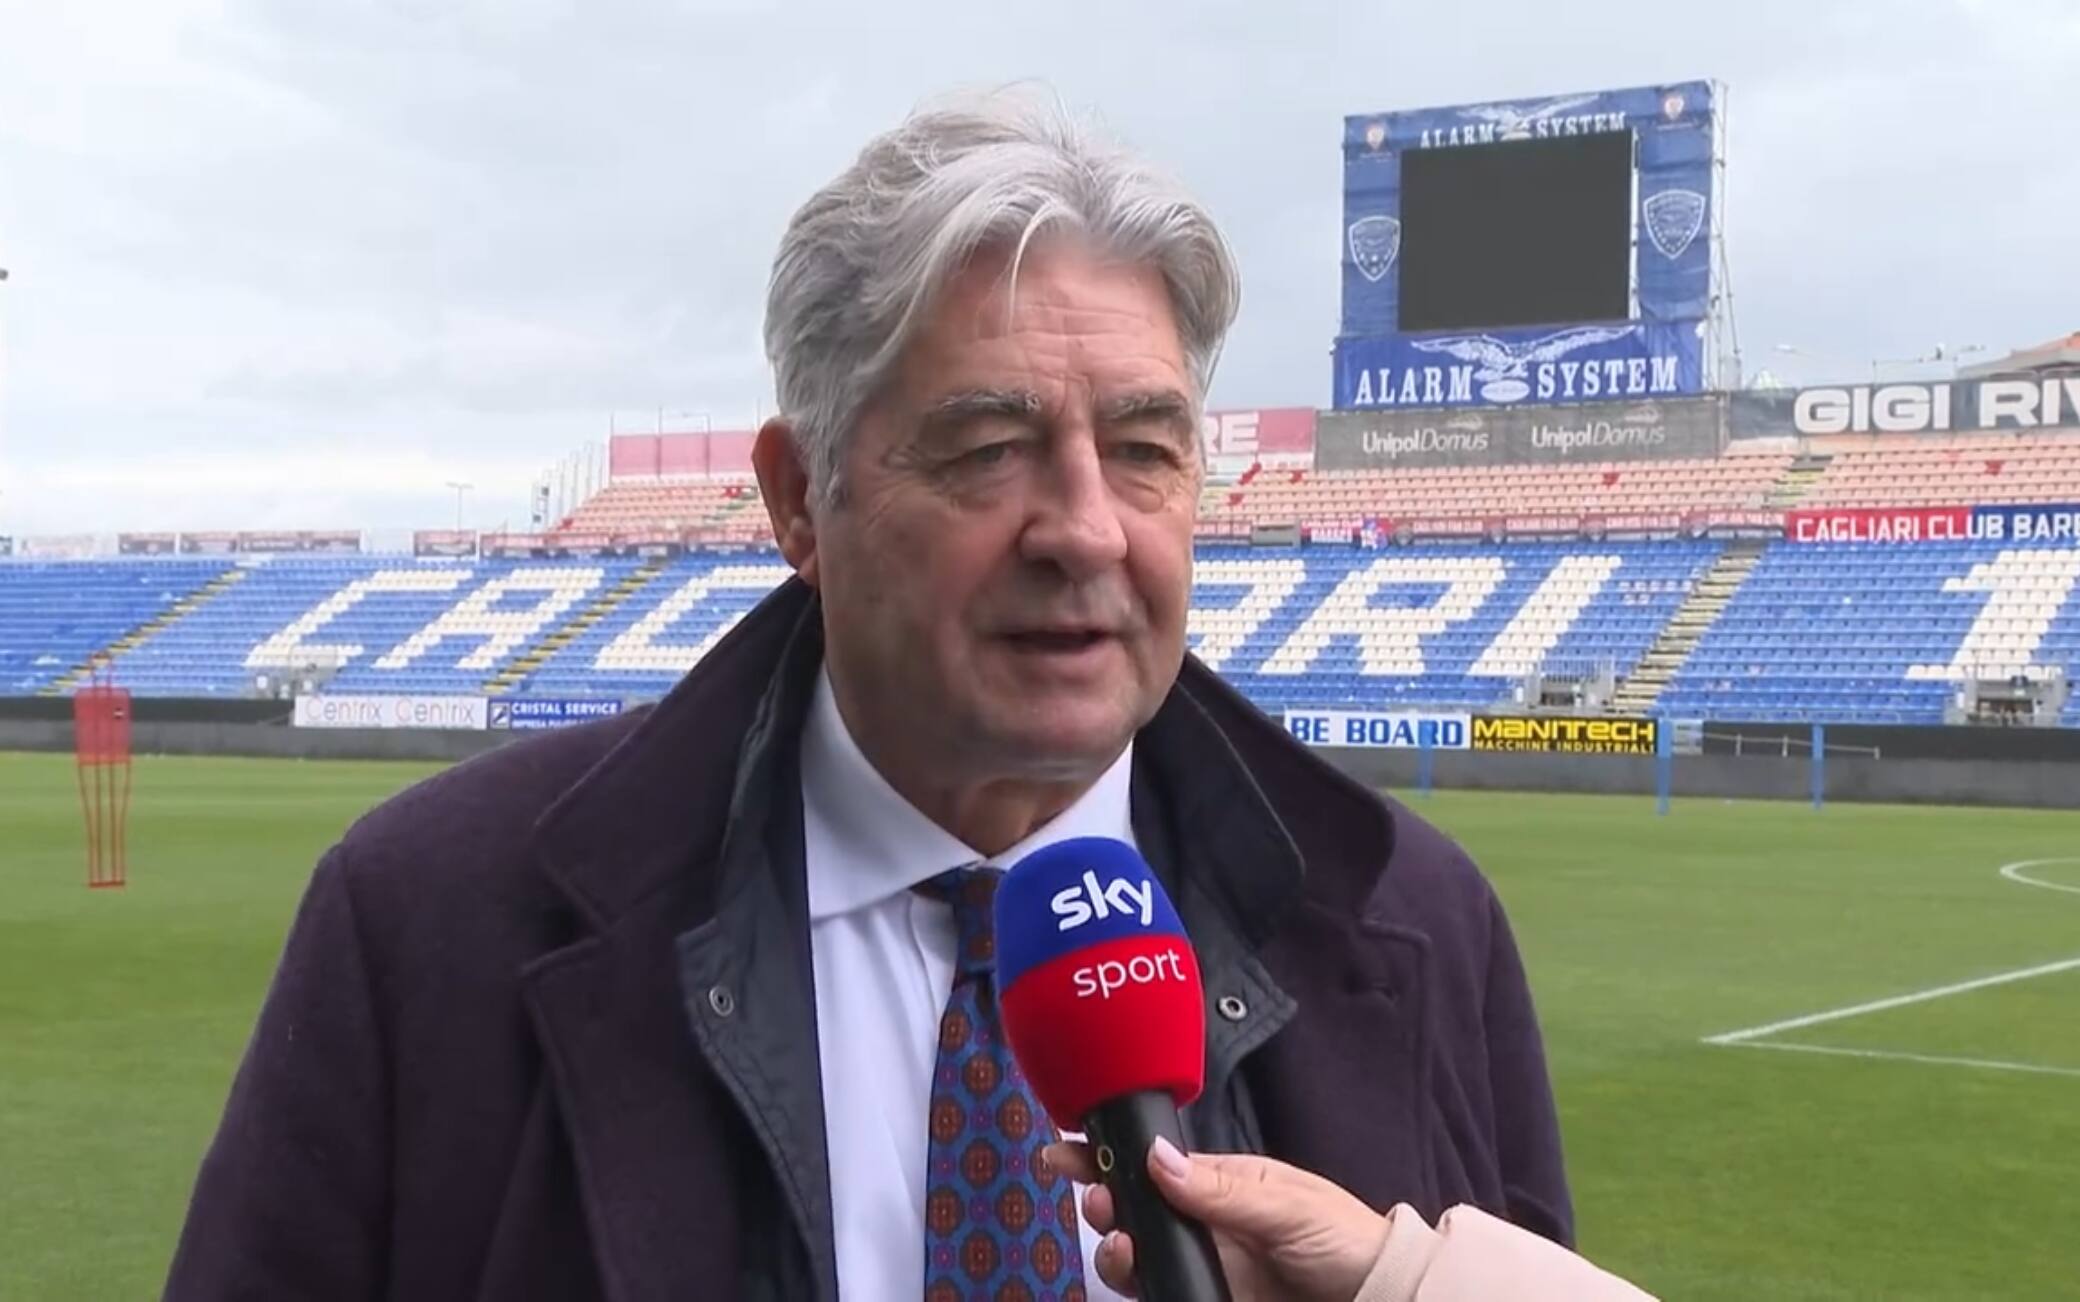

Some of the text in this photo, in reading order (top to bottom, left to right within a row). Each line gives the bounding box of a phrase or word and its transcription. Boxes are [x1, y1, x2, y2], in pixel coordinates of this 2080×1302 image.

[1420, 112, 1626, 149] ALARM SYSTEM
[1354, 356, 1679, 405] ALARM SYSTEM
[1794, 383, 1951, 434] GIGI
[1362, 428, 1489, 459] UnipolDomus
[1531, 421, 1665, 455] UnipolDomus
[1797, 514, 1920, 542] CAGLIARI
[1928, 514, 2004, 540] CLUB
[306, 697, 475, 723] Centrix Centrix
[511, 701, 617, 715] CRISTAL SERVICE
[1474, 741, 1654, 754] MACCHINE INDUSTRIALI
[1050, 869, 1153, 932] sky
[1073, 948, 1187, 999] sport
